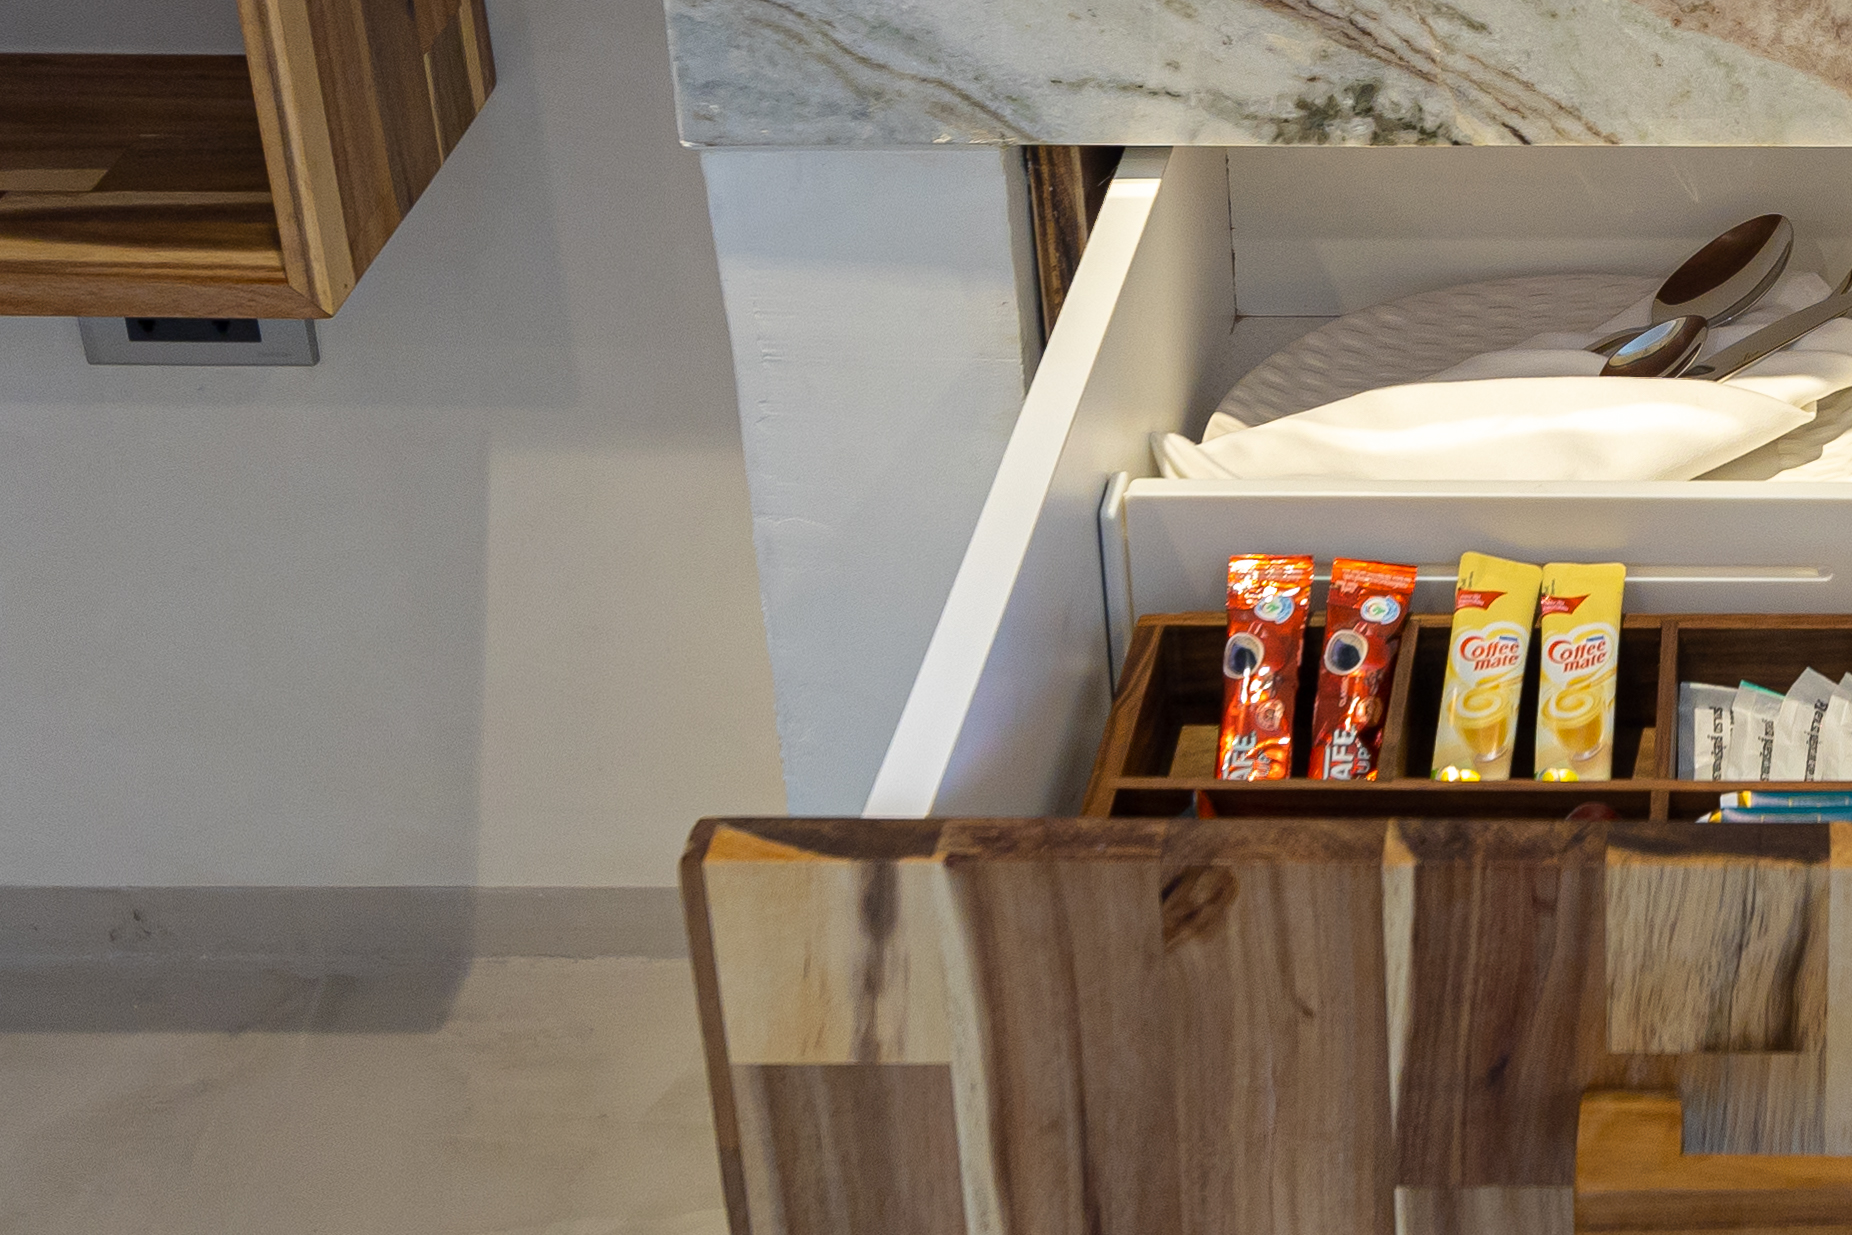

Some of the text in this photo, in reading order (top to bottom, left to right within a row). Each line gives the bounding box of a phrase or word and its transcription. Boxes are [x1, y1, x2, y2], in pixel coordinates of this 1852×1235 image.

[1459, 635, 1520, 662] Coffee
[1547, 640, 1606, 664] Coffee
[1474, 655, 1521, 671] mate
[1563, 652, 1607, 673] mate
